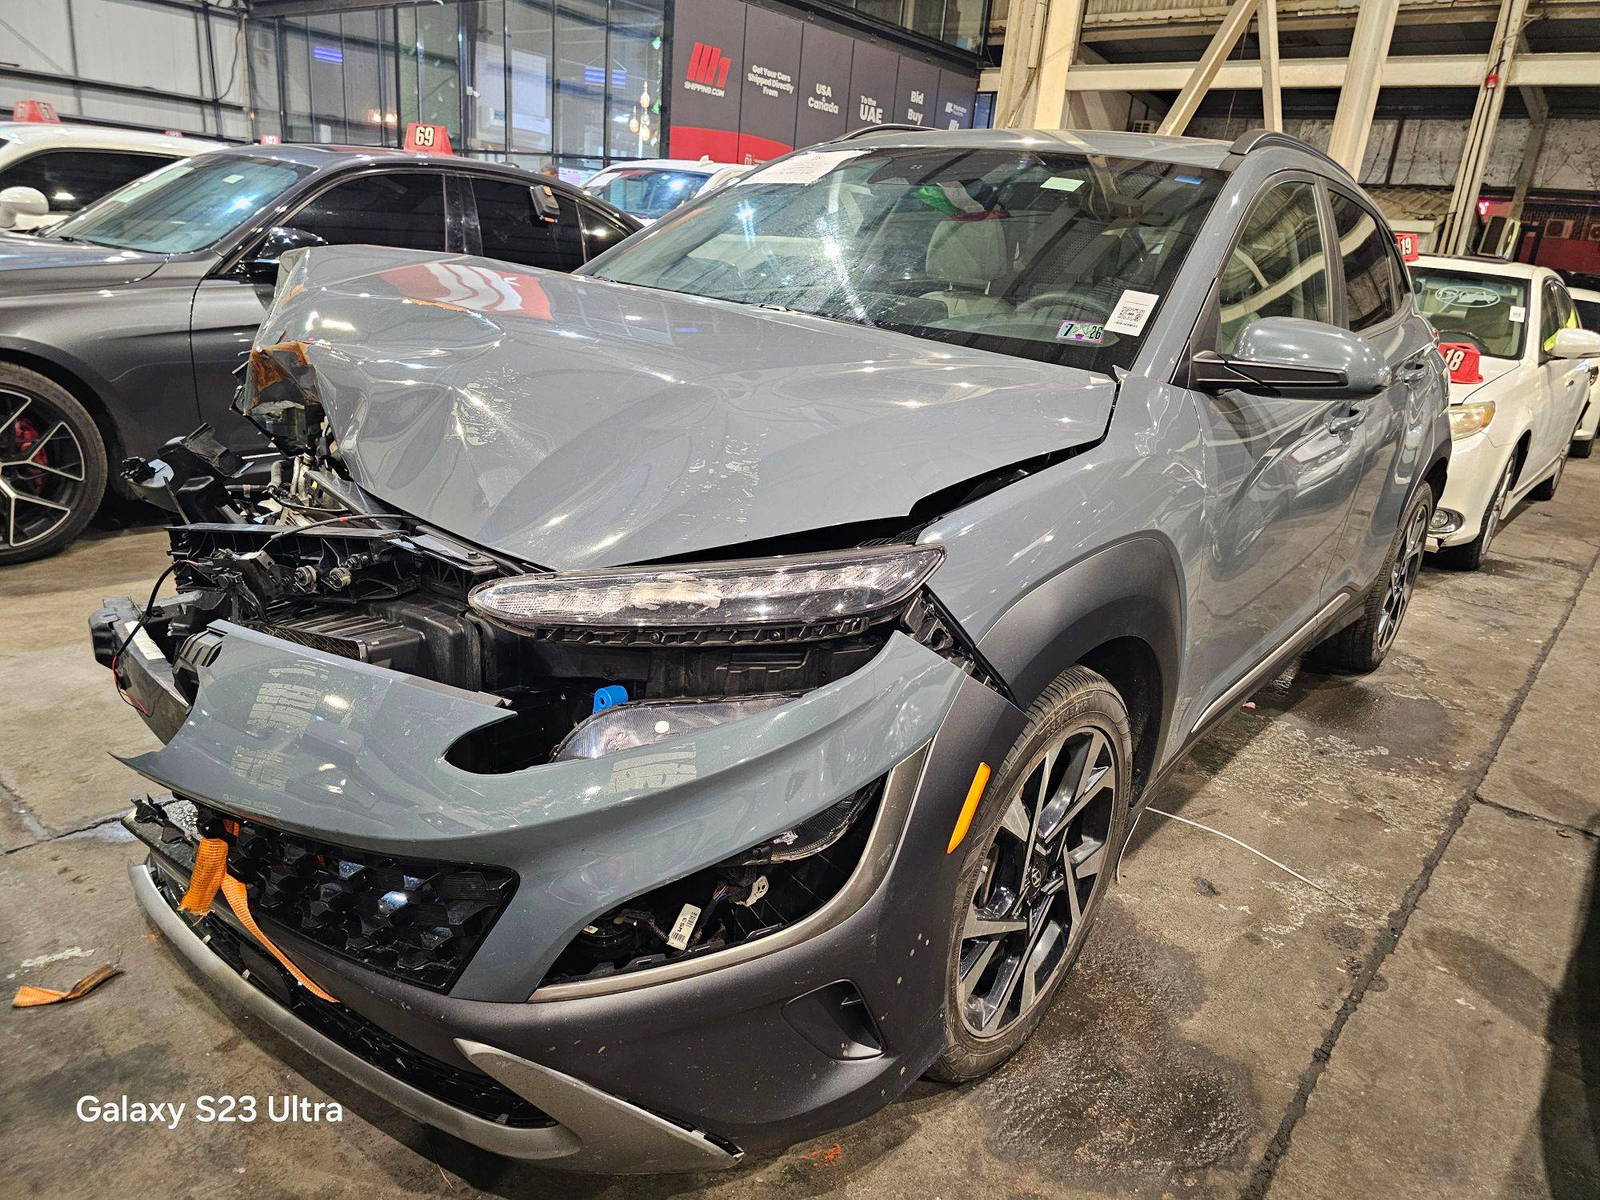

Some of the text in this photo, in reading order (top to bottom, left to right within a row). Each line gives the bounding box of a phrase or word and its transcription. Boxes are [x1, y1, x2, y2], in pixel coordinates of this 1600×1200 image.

[763, 67, 778, 78] Your
[777, 72, 791, 82] Cars
[684, 81, 725, 97] SHIPPING.COM
[747, 73, 795, 94] Shipped Directly
[762, 86, 779, 97] From
[815, 83, 832, 97] USA
[807, 97, 839, 114] Canada
[860, 95, 877, 106] To the
[910, 90, 924, 105] Bid
[859, 104, 883, 124] UAE
[907, 108, 924, 125] Buy
[415, 126, 434, 146] 69
[1400, 237, 1412, 255] 19
[1063, 323, 1103, 339] 7 26
[1445, 349, 1465, 371] 18
